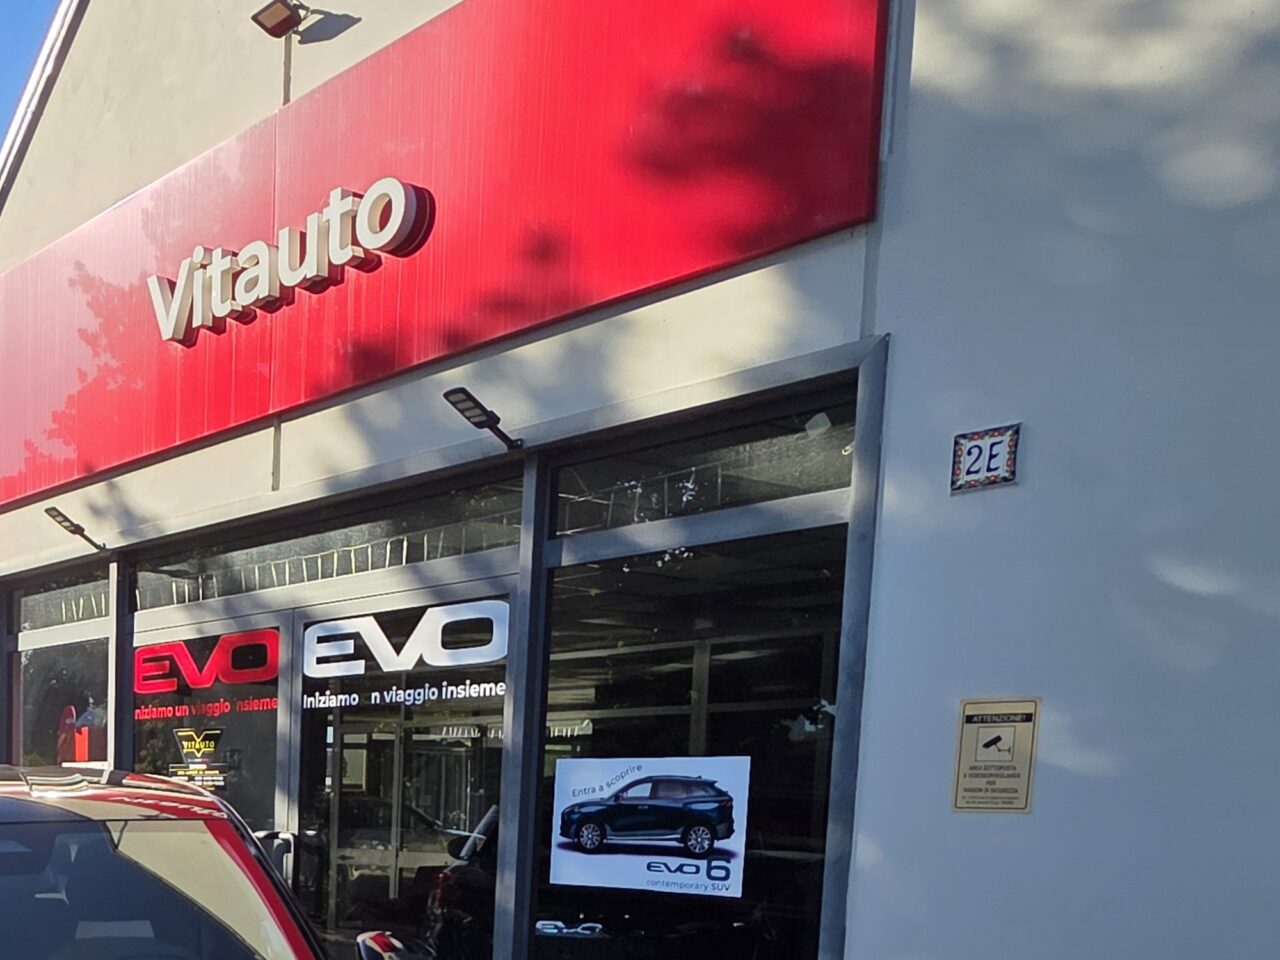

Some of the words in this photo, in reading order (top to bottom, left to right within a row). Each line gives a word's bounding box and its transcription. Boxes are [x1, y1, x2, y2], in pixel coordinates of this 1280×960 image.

[147, 176, 411, 342] Vitauto
[965, 440, 1004, 476] 2E
[303, 600, 510, 678] EVO
[134, 628, 280, 694] EVO
[134, 704, 173, 720] niziamo
[175, 703, 189, 717] un
[234, 695, 278, 711] nsieme
[303, 690, 359, 709] Iniziamo
[383, 683, 439, 705] viaggio
[441, 680, 507, 699] insieme
[572, 785, 596, 798] Entra
[606, 764, 643, 789] scoprire
[646, 861, 701, 875] EVO
[706, 855, 732, 881] 6
[646, 879, 712, 892] contemporary
[711, 882, 731, 892] SUV
